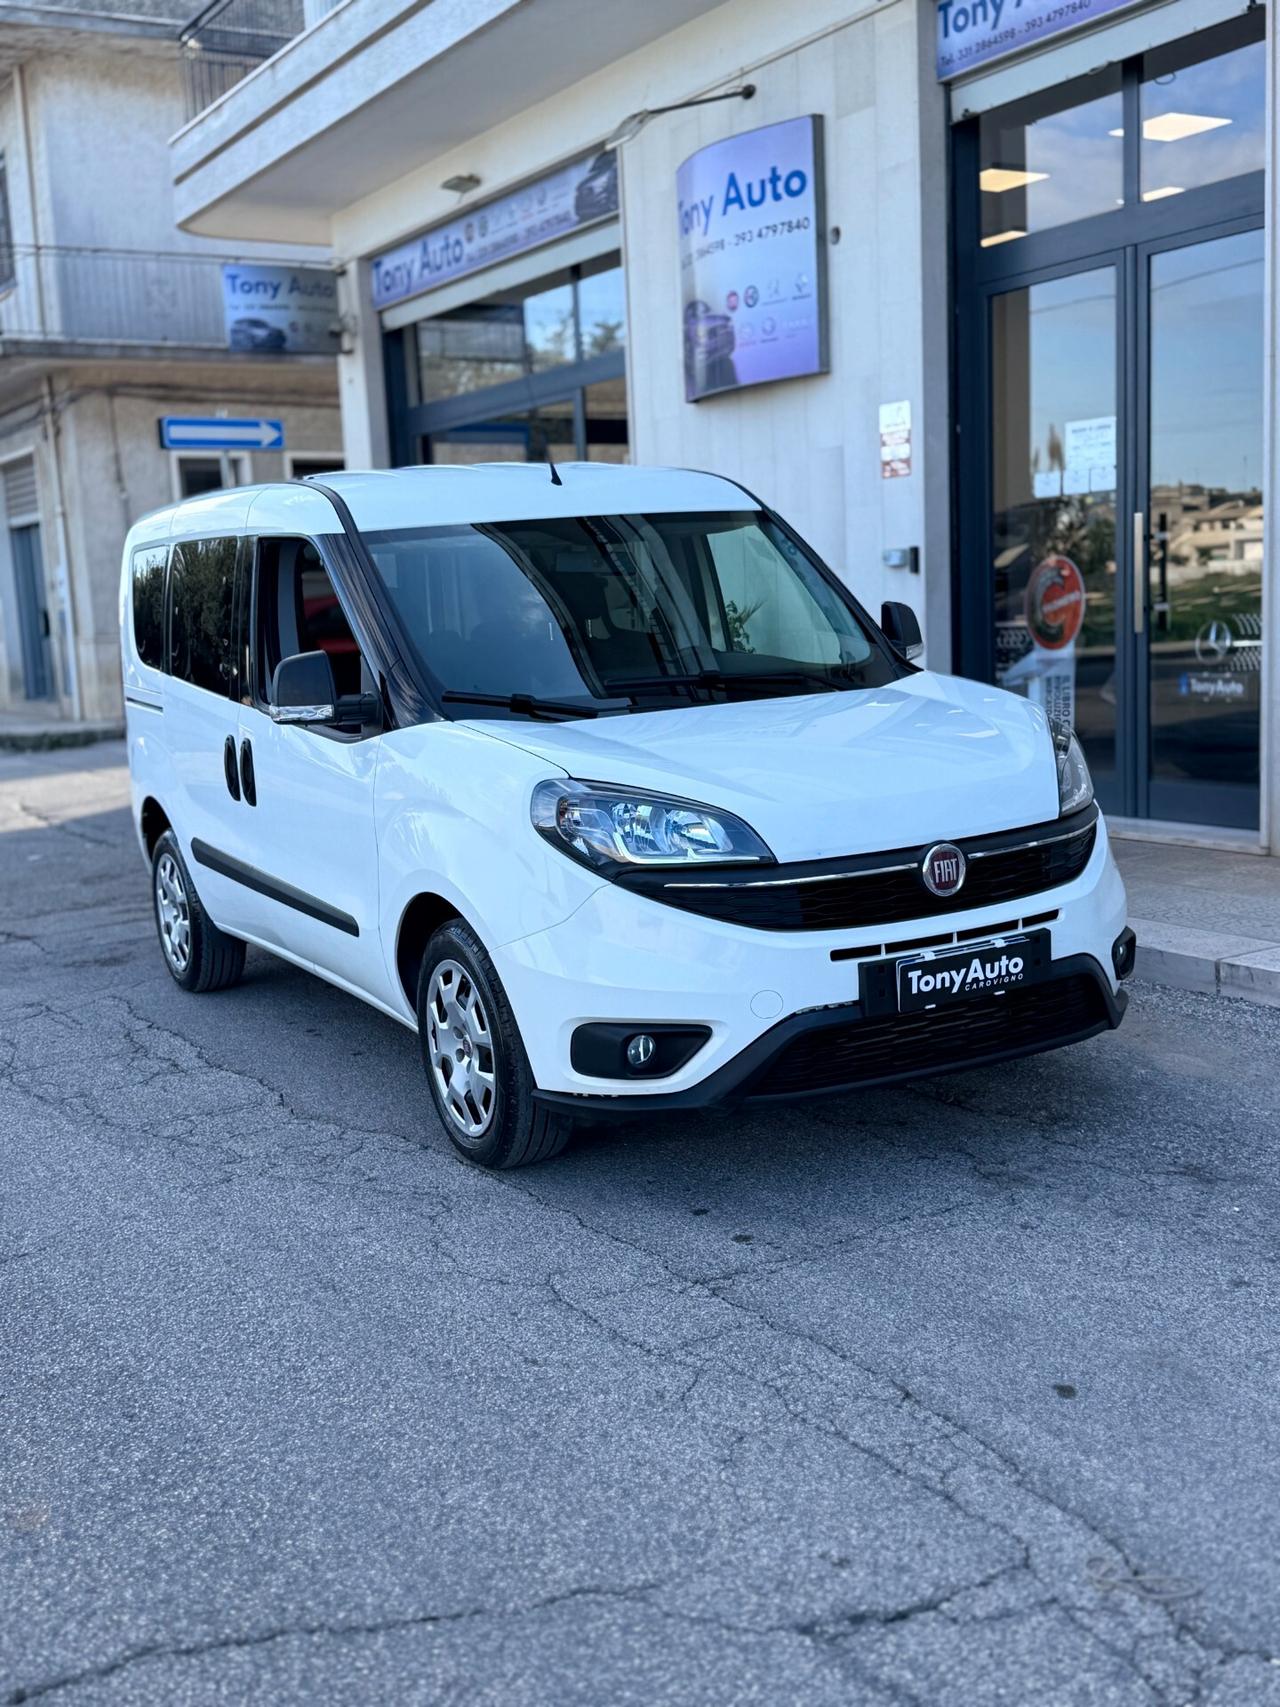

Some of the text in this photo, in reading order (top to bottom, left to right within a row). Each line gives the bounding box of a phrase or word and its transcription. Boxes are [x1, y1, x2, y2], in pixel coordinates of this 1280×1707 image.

[938, 0, 1004, 38] Tony
[1024, 16, 1043, 33] 393
[722, 166, 807, 216] Auto
[757, 217, 810, 244] 4797840
[373, 258, 415, 295] Tony
[418, 235, 463, 280] Auto
[226, 274, 335, 300] Tony Auto
[934, 858, 958, 883] FIAT
[908, 955, 1024, 993] TonyAuto
[965, 973, 1024, 991] CAROVIGNO
